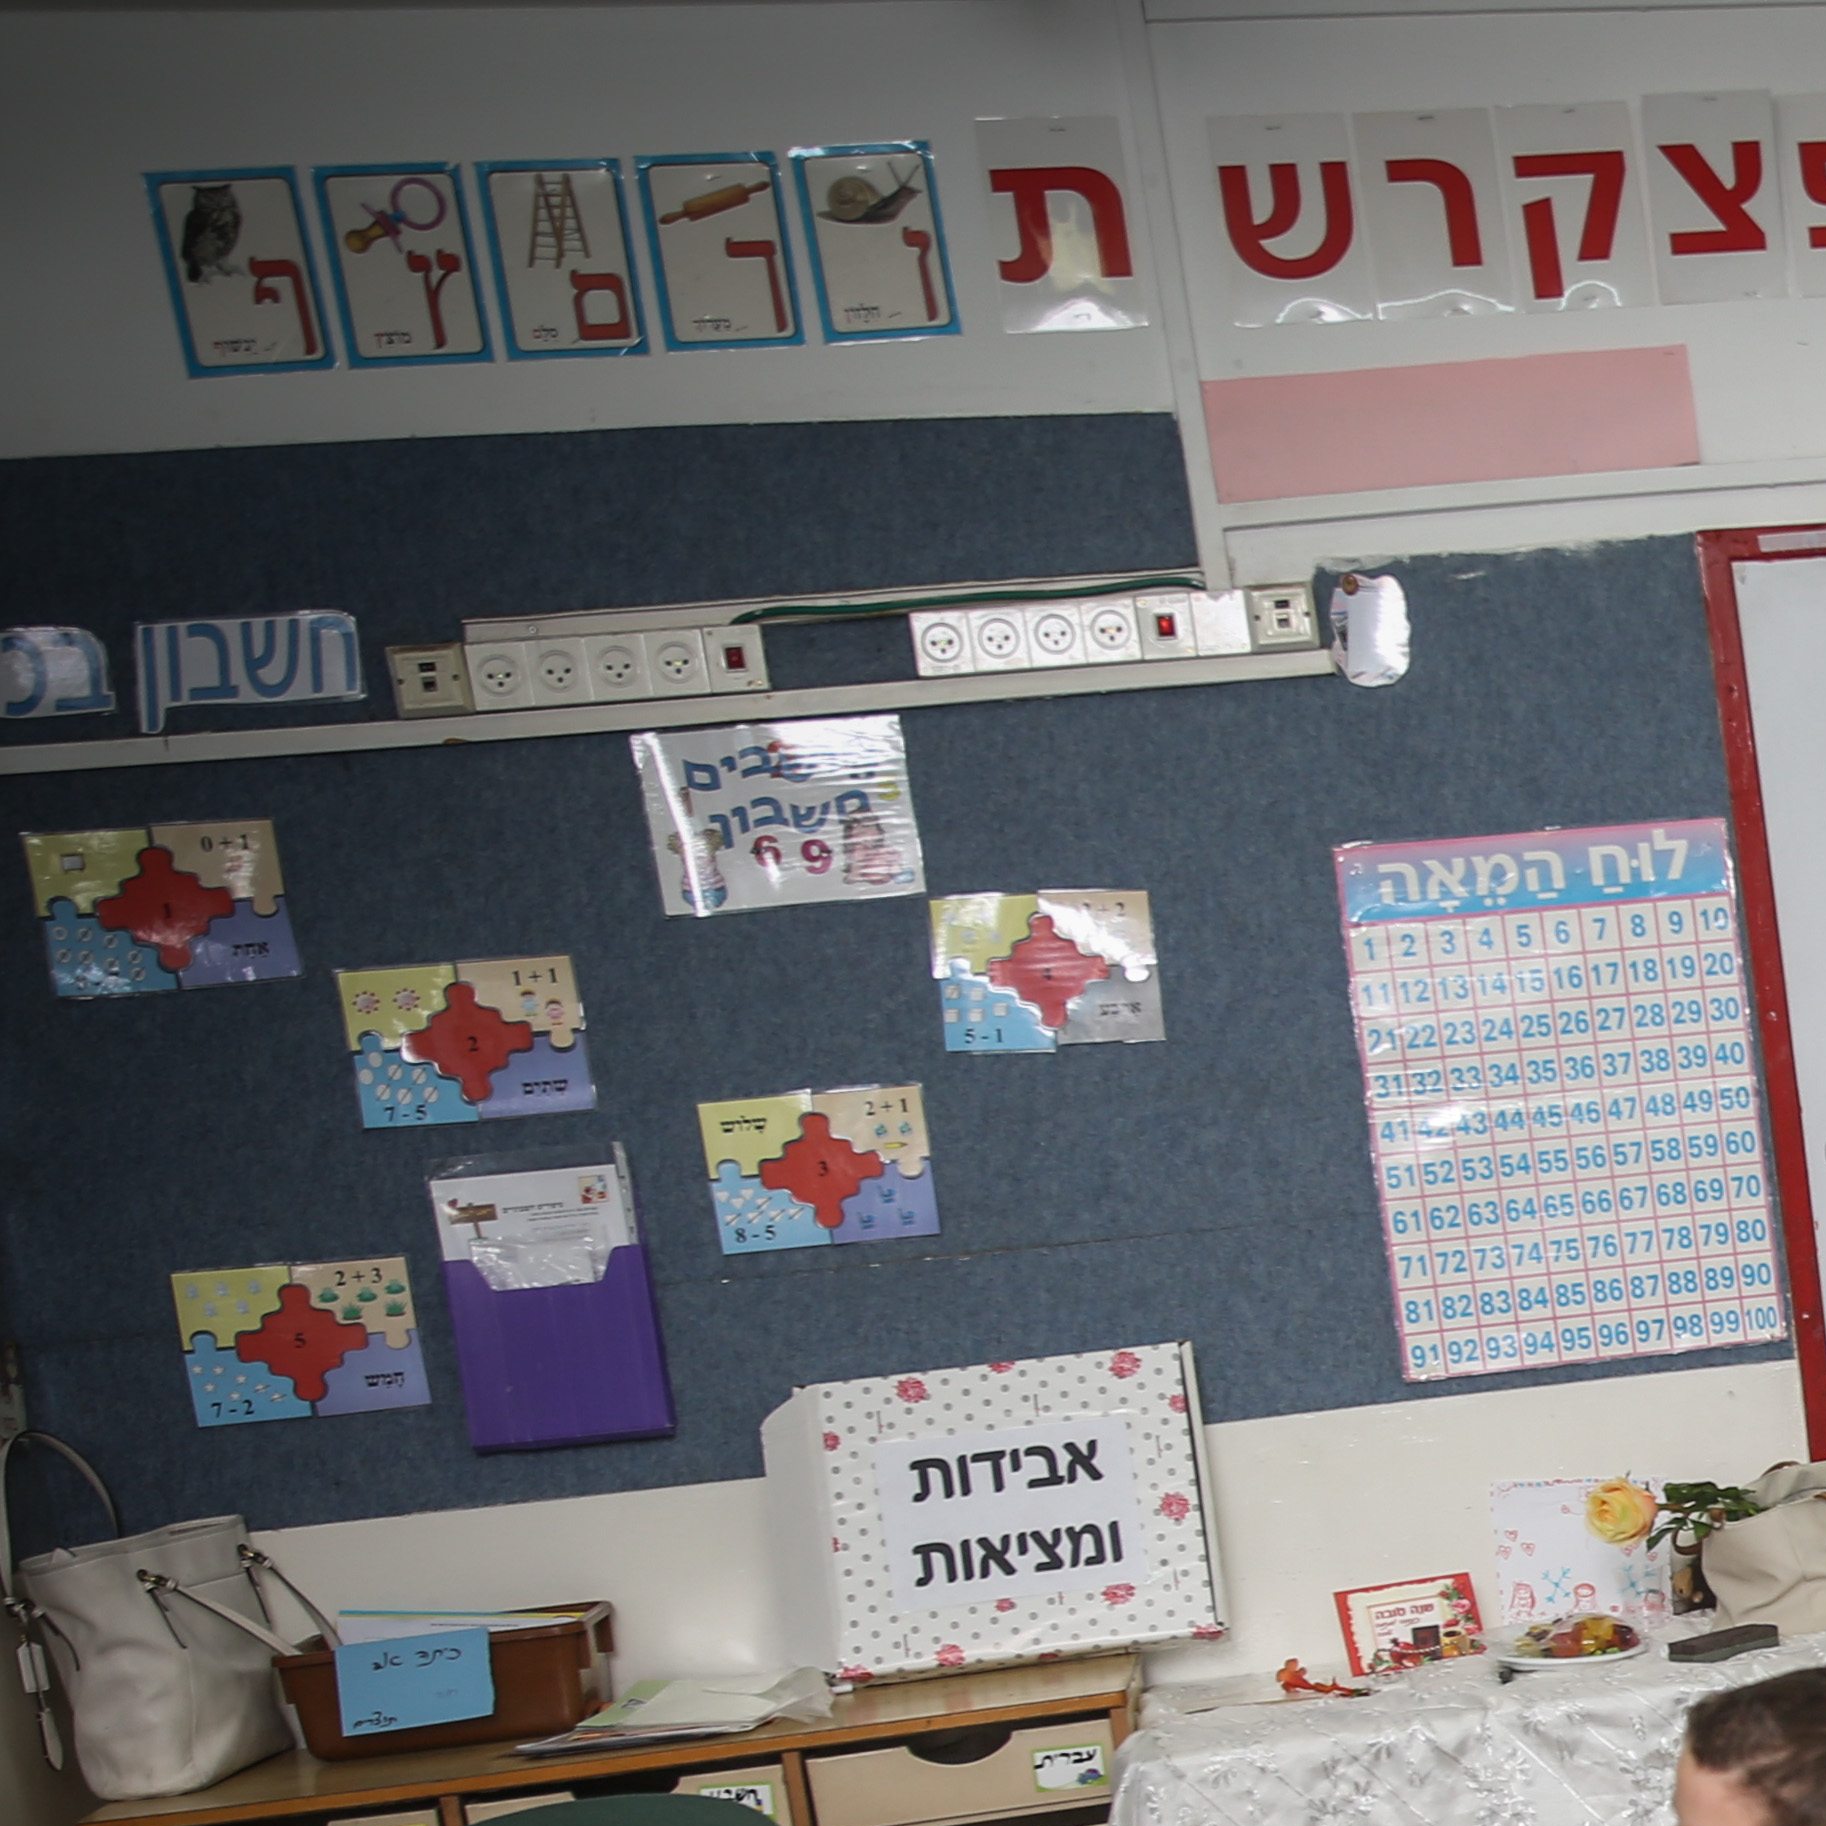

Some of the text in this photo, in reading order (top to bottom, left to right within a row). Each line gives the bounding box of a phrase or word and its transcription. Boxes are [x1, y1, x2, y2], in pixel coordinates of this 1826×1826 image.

[142, 615, 356, 732] חשבון
[801, 839, 833, 874] 9
[512, 970, 521, 985] 1
[549, 968, 557, 983] 1
[467, 1036, 479, 1052] 2
[383, 1107, 395, 1122] 7
[415, 1105, 426, 1120] 5
[866, 1101, 876, 1116] 2
[900, 1098, 908, 1112] 1
[1386, 1130, 1756, 1189] 51 52 53 54 55 56 57 58 59 60
[817, 1161, 829, 1177] 3
[734, 1228, 747, 1243] 8
[765, 1225, 775, 1240] 5
[335, 1271, 346, 1286] 2
[371, 1268, 382, 1283] 3
[294, 1333, 306, 1348] 5
[211, 1403, 222, 1418] 7
[243, 1400, 254, 1415] 2
[910, 1439, 1104, 1502] אבידות
[912, 1520, 1124, 1587] ומציאות
